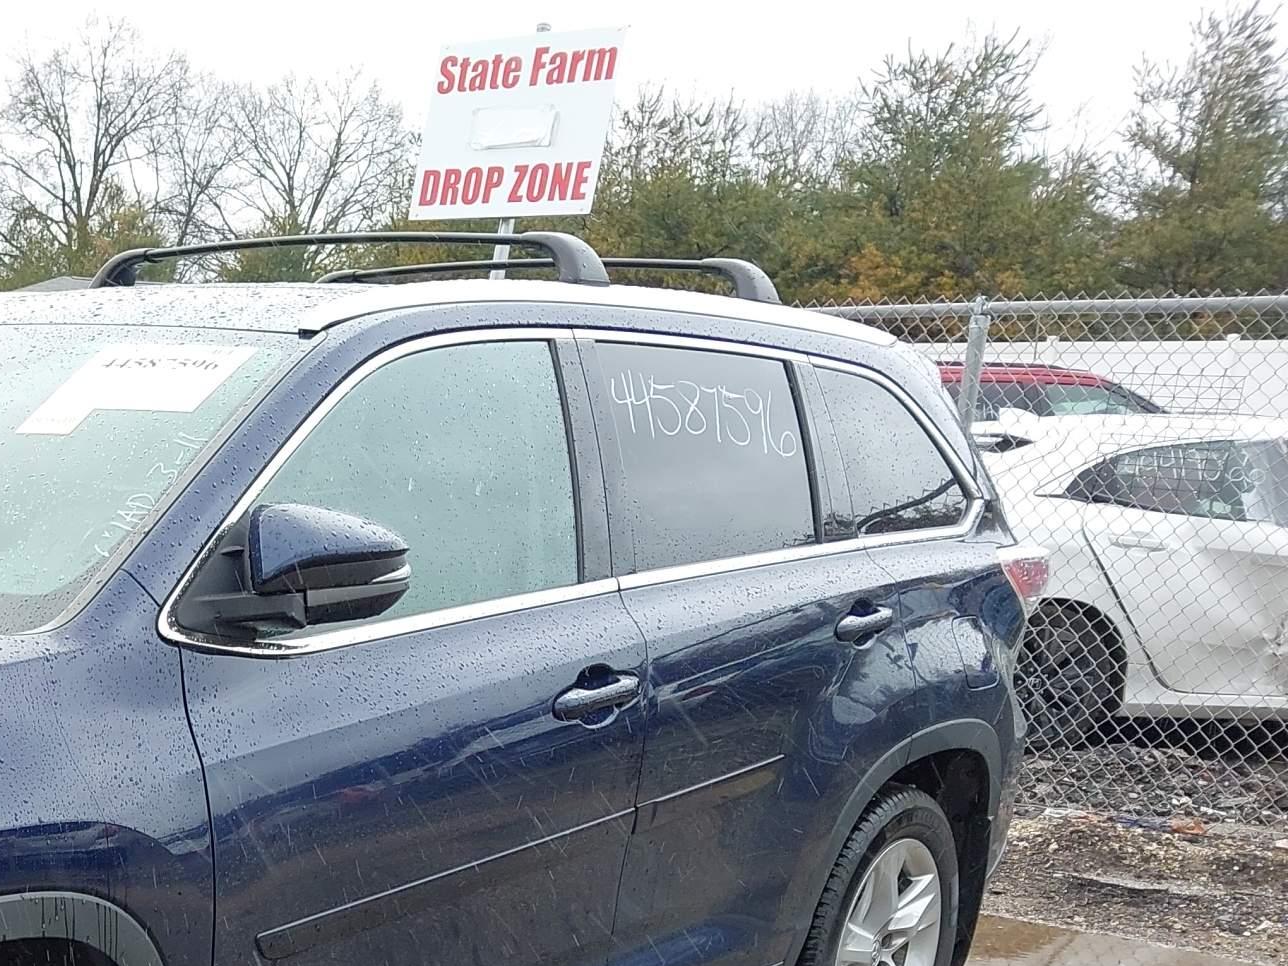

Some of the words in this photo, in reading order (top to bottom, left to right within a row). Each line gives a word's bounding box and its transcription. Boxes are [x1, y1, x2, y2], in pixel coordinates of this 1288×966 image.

[436, 53, 523, 95] State
[528, 46, 619, 87] Farm
[418, 165, 505, 207] DROP
[507, 160, 593, 204] ZONE
[610, 368, 798, 457] 44587596
